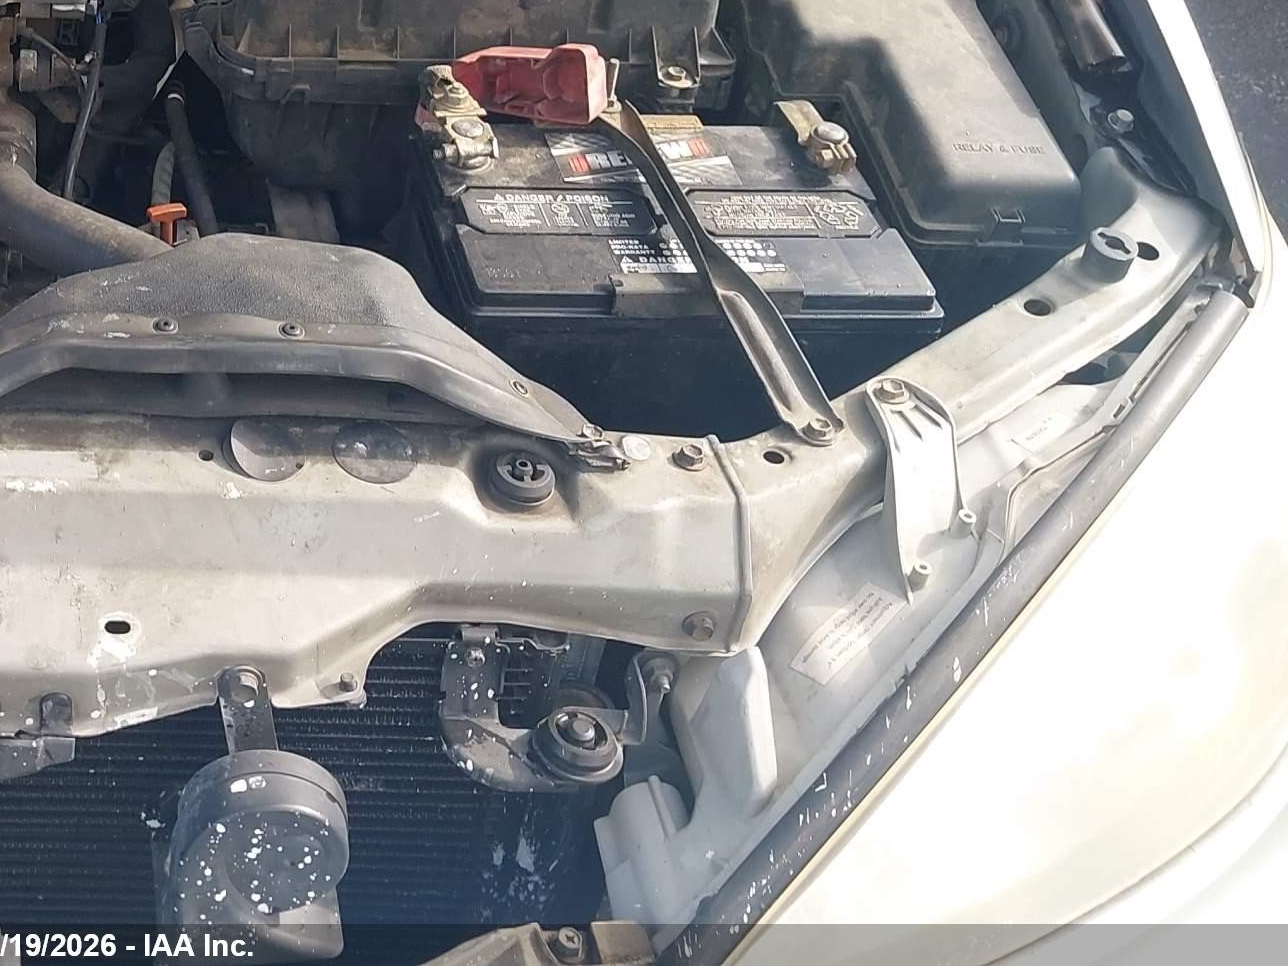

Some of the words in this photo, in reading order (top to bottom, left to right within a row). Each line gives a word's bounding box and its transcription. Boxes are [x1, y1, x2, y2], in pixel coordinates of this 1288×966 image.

[952, 143, 993, 153] RELAY
[505, 194, 553, 202] DANGER
[565, 195, 610, 203] POISON
